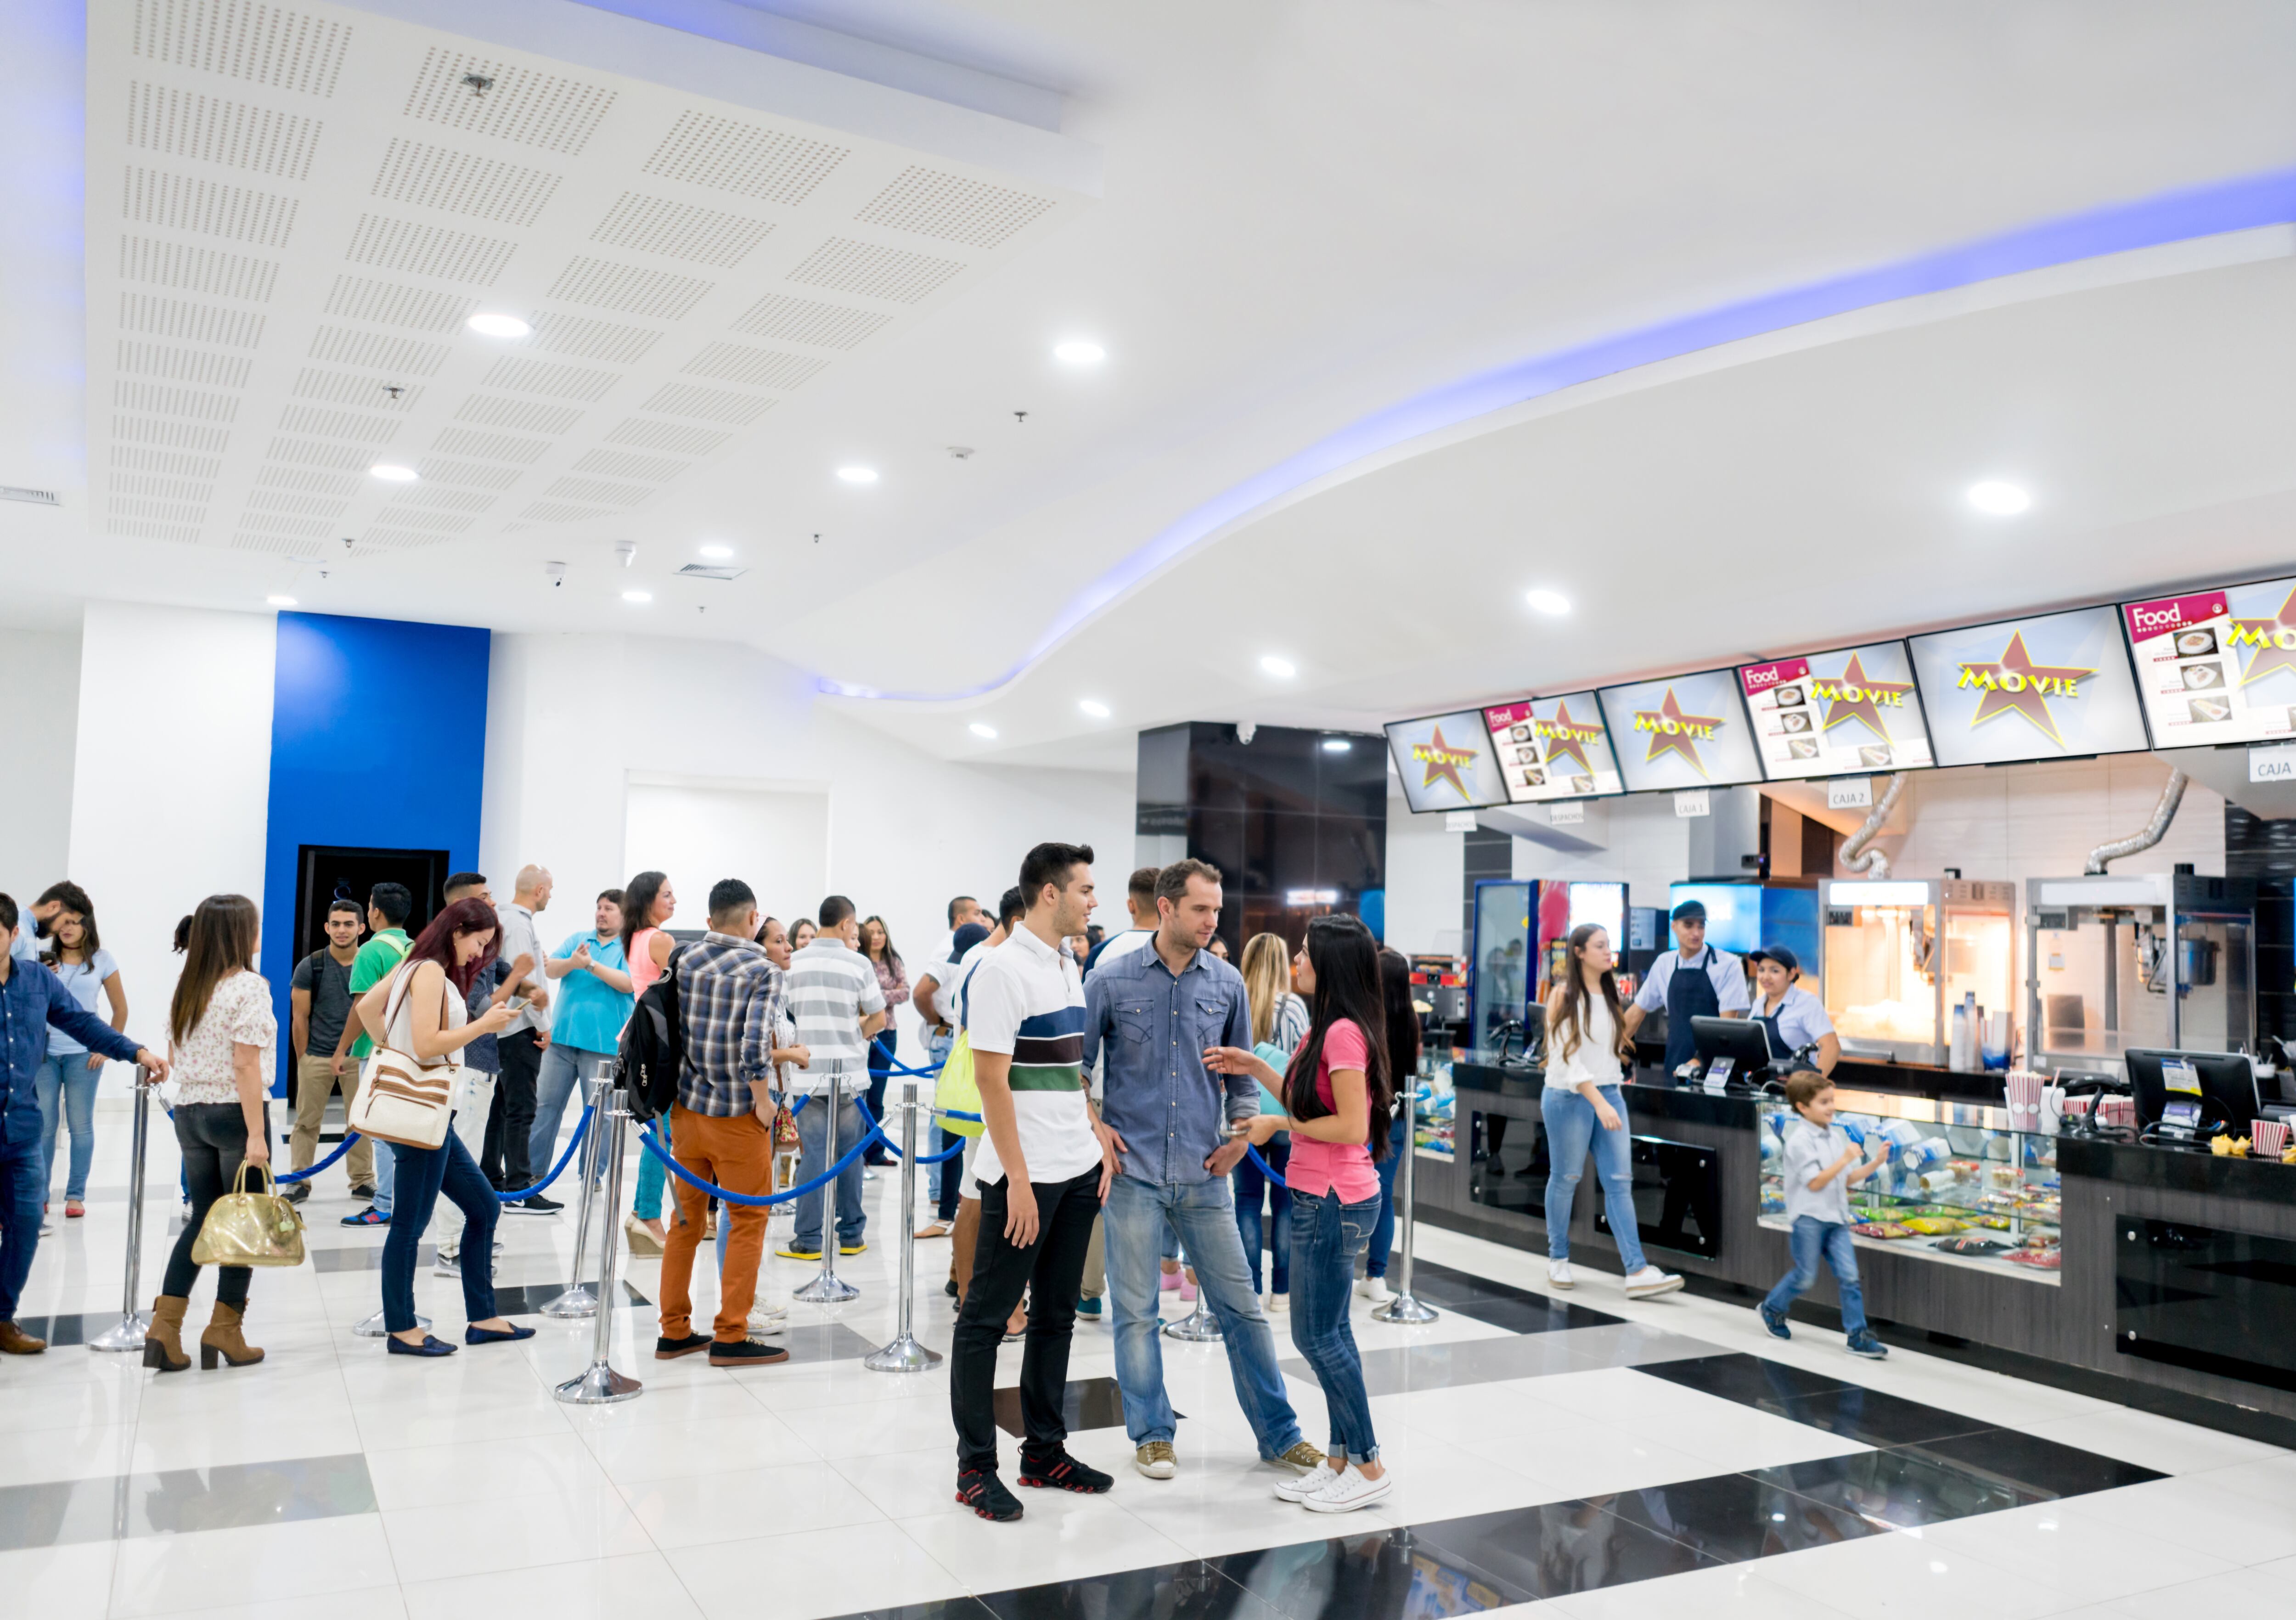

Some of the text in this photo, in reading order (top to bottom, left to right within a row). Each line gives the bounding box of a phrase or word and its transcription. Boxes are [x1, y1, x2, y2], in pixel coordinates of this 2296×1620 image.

[2133, 602, 2181, 627] Food
[1745, 666, 1779, 684] Food
[1957, 667, 2078, 697] MOVIE
[1811, 682, 1903, 707] MOVIE
[1489, 709, 1513, 724] Food
[1634, 714, 1714, 740] MOVIE
[1535, 723, 1598, 744] MOVIE
[1412, 747, 1472, 769] MOVIE
[2258, 762, 2291, 776] CAJA
[1679, 803, 1703, 813] CAJA 1
[1833, 793, 1864, 804] CAJA 2
